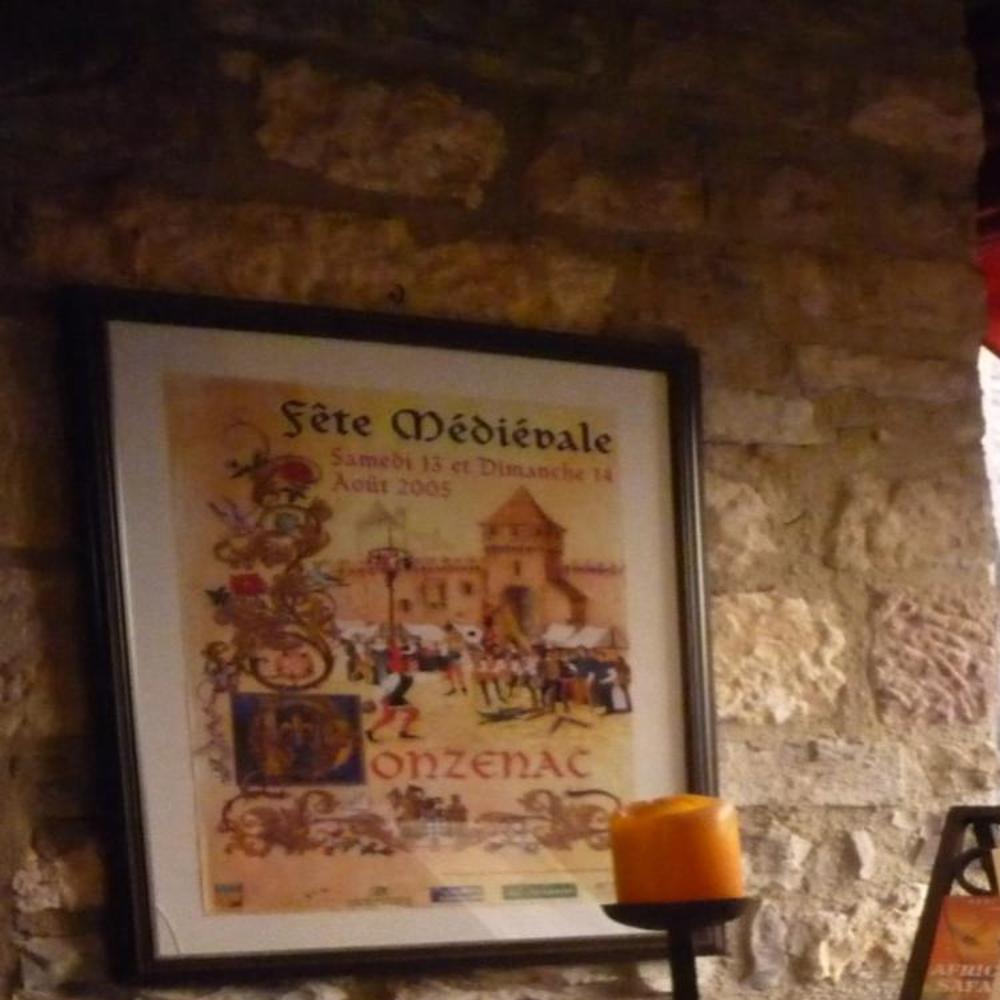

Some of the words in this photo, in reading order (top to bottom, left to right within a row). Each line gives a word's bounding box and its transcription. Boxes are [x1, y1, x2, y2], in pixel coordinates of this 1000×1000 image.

[281, 400, 372, 438] Fête
[391, 408, 613, 453] Médiévale
[331, 448, 412, 471] Samedi
[452, 458, 470, 474] et
[478, 457, 584, 480] Dimanche
[398, 477, 451, 498] 2005
